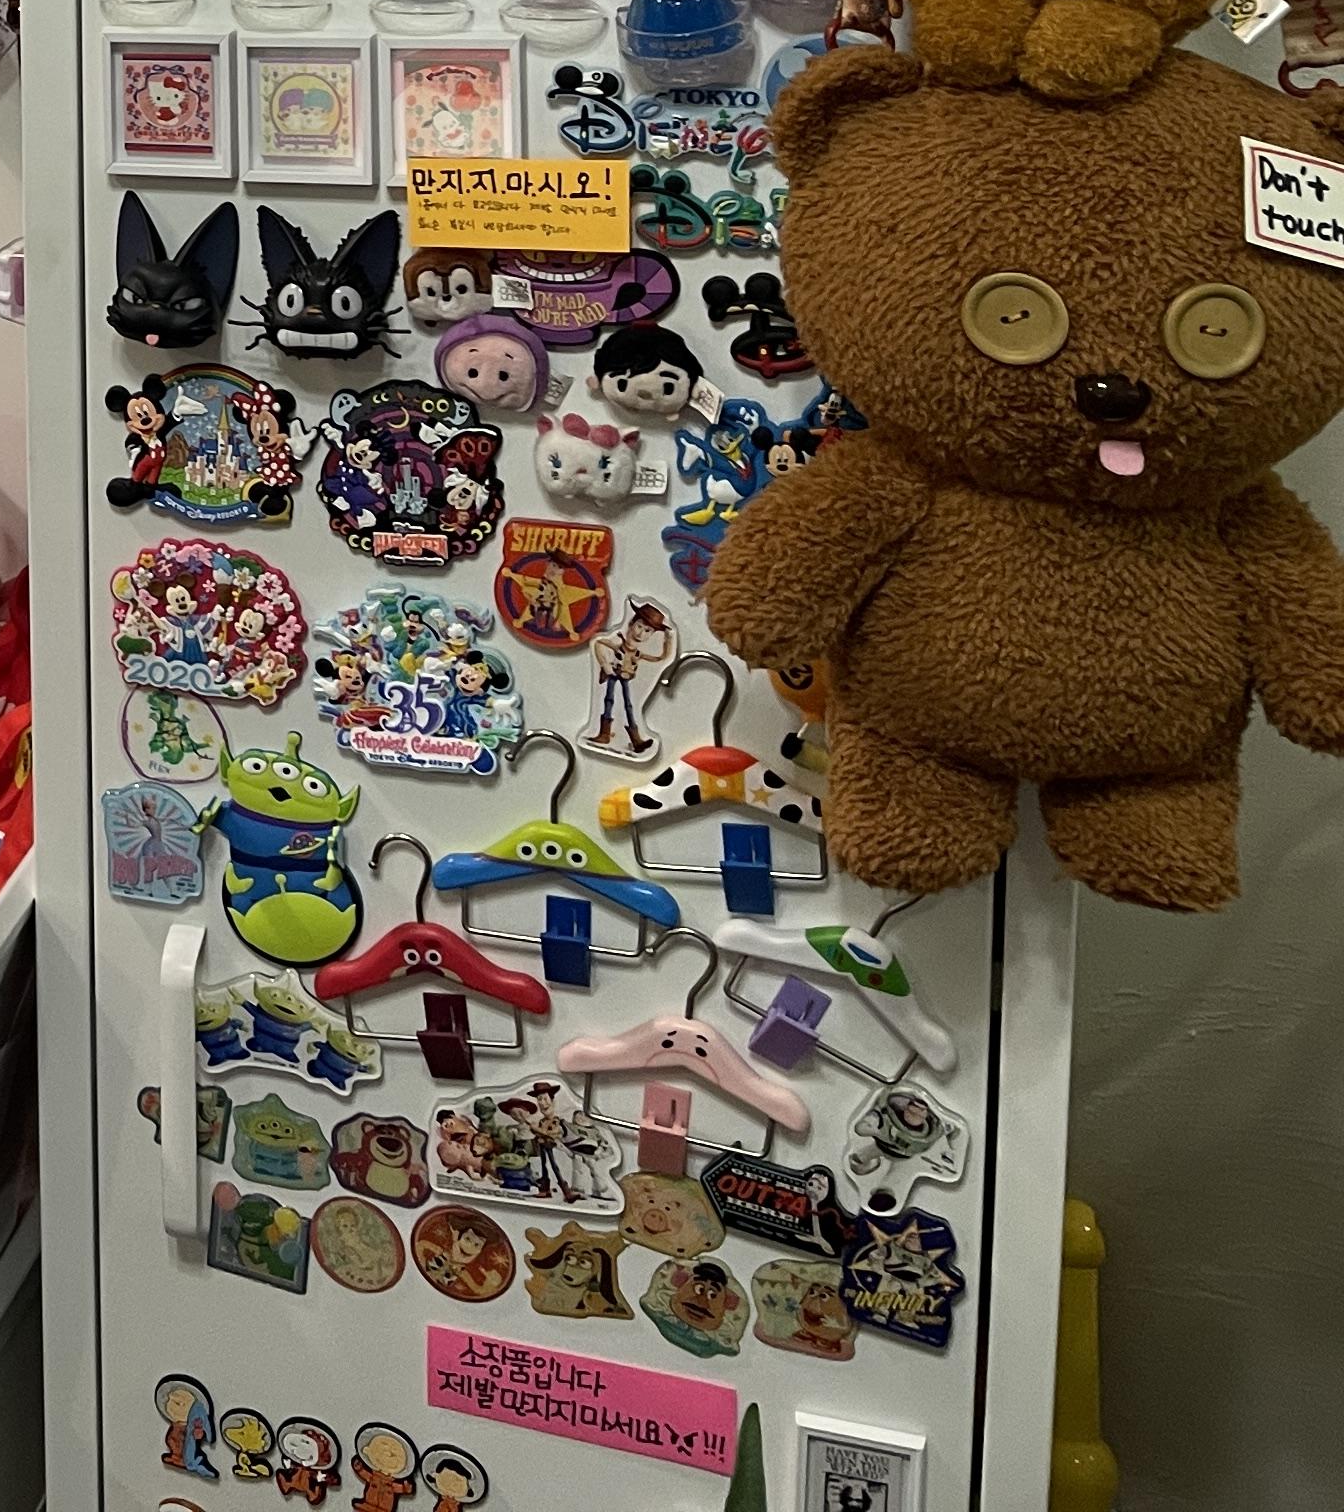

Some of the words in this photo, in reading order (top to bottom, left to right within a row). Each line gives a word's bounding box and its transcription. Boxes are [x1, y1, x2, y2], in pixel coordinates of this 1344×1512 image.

[672, 89, 760, 108] TOKYO
[1258, 154, 1330, 203] Don't
[1261, 204, 1344, 243] touch
[163, 496, 186, 512] TOKYO
[187, 505, 216, 523] Disney
[216, 507, 242, 521] RESORT
[510, 526, 606, 555] SHERIFF
[127, 658, 212, 689] 2020
[380, 676, 446, 735] 35
[353, 731, 408, 754] Happiest
[411, 739, 482, 761] Celebration!
[368, 752, 396, 762] TOKYO
[397, 753, 428, 765] Disney
[428, 757, 463, 769] RESORT
[113, 851, 140, 885] BO
[716, 1174, 809, 1218] OUTTA
[853, 1290, 946, 1314] INFINITY
[458, 1336, 607, 1398] 소장품입니다
[826, 1445, 859, 1461] HAVE
[862, 1452, 891, 1467] YOU
[826, 1455, 857, 1469] SEEN
[860, 1461, 891, 1475] THIS
